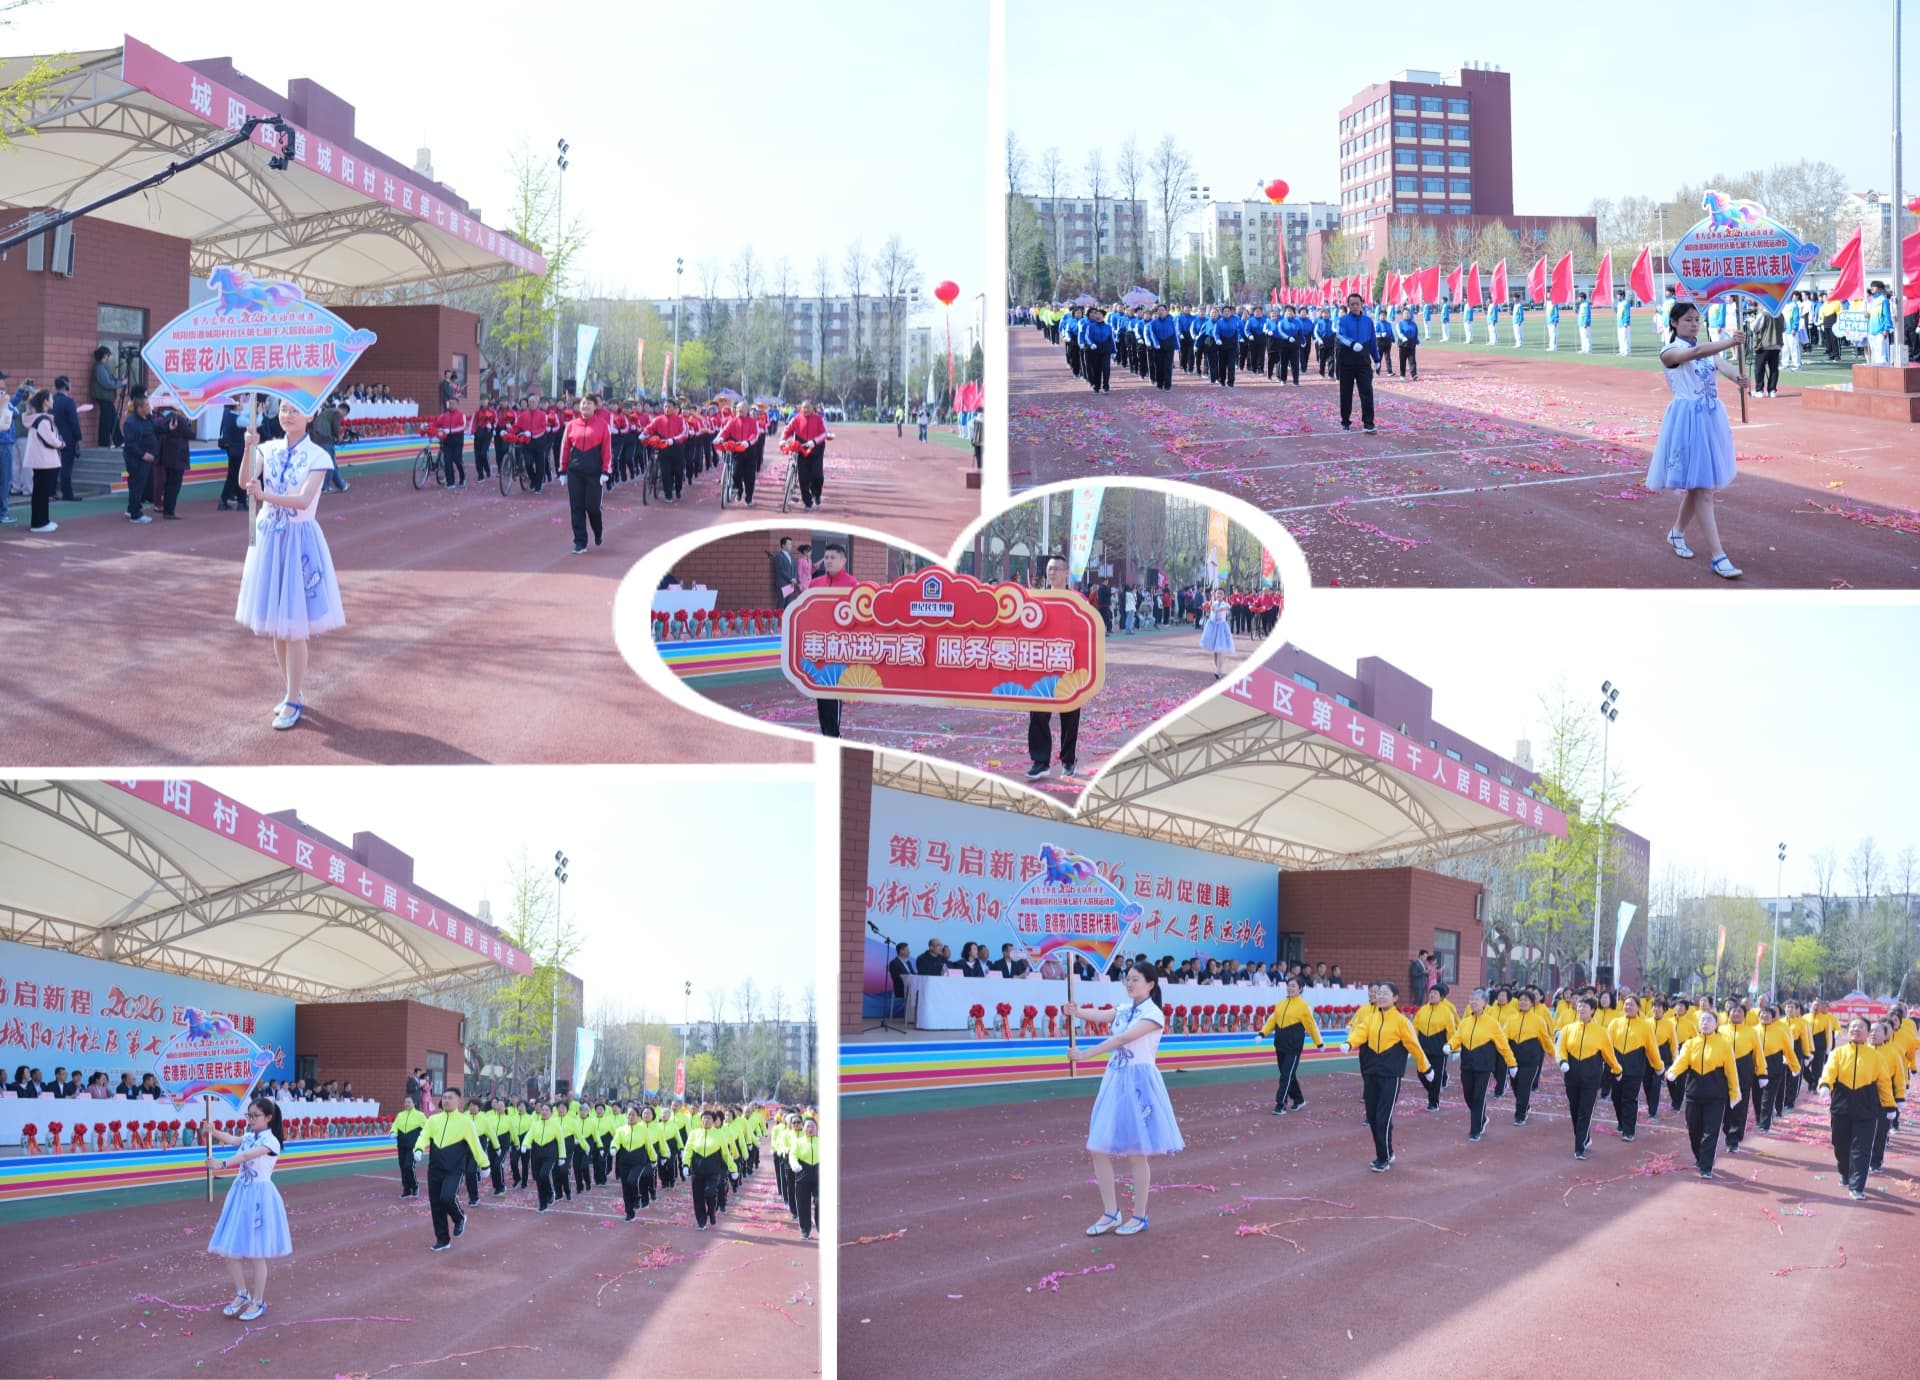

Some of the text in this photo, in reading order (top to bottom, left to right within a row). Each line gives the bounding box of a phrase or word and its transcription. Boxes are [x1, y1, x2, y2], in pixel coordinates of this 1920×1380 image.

[1681, 254, 1794, 278] 东樱花小区居民代表队
[164, 342, 339, 373] 西樱花小区居民代表队
[801, 631, 1075, 673] 奉献进万家 服务零距离
[120, 779, 514, 965] 阳村社区第七届千人居民运动会
[1134, 872, 1231, 908] 运动促健康
[100, 984, 164, 1023] 2026
